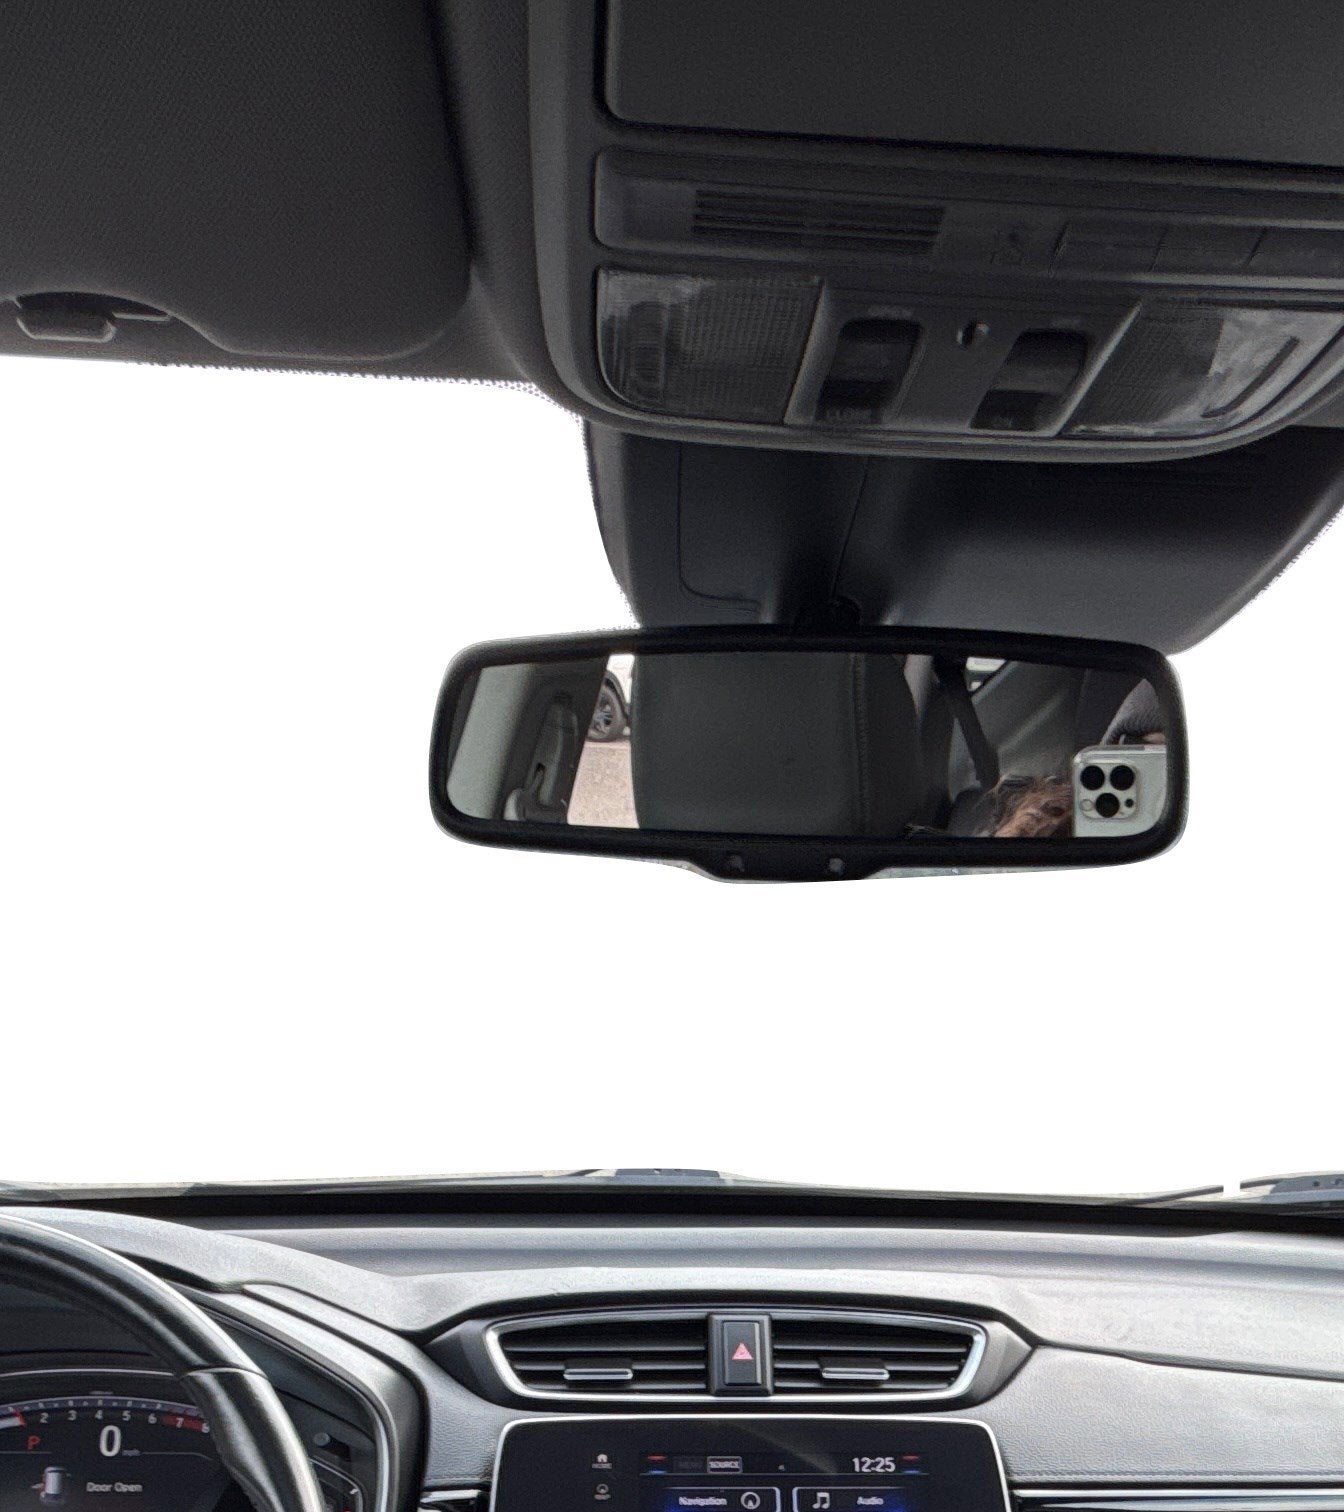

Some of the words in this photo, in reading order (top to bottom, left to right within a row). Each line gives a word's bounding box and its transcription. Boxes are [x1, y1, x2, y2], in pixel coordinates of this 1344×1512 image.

[39, 1412, 49, 1424] 2
[67, 1410, 77, 1421] 3
[94, 1409, 104, 1420] 4
[122, 1410, 132, 1421] 5
[147, 1412, 158, 1425] 6
[99, 1425, 121, 1457] 0
[852, 1456, 896, 1473] 12:25
[86, 1482, 111, 1493] Door
[114, 1482, 143, 1494] Open
[678, 1496, 728, 1507] Navigation
[856, 1496, 885, 1506] Audio
